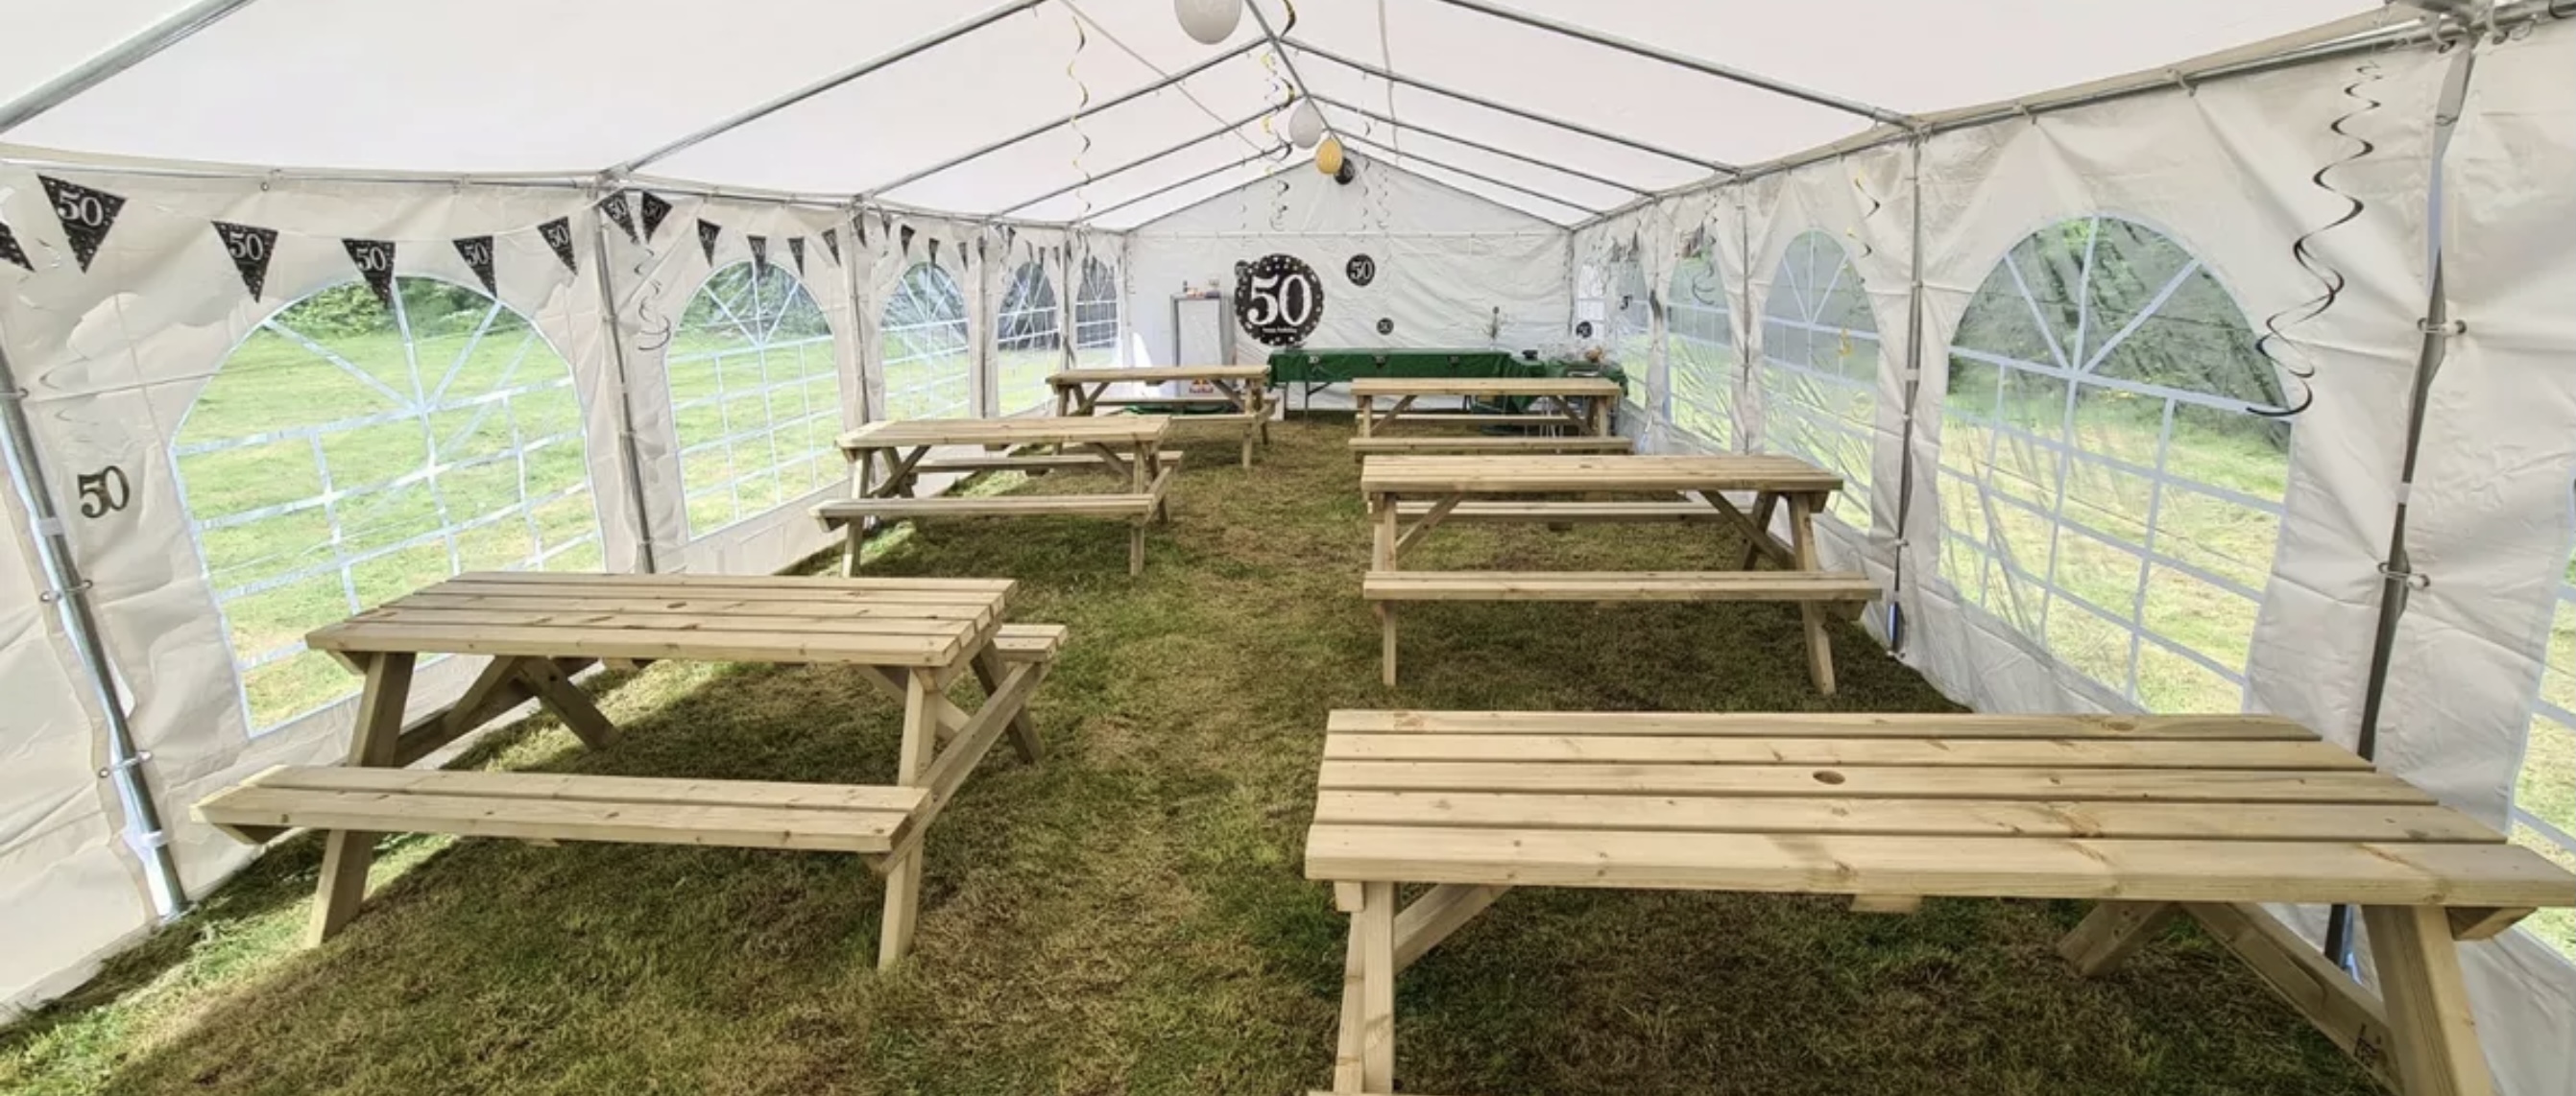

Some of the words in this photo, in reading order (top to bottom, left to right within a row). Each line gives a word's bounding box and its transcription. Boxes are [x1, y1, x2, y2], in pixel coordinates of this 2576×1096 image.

[58, 189, 103, 226] 50
[608, 198, 627, 219] 50
[229, 231, 263, 260] 50
[549, 226, 568, 248] 50
[355, 246, 386, 271] 50
[465, 245, 489, 265] 50
[1350, 261, 1373, 280] 50
[1247, 274, 1312, 326] 50
[77, 465, 130, 518] 50
